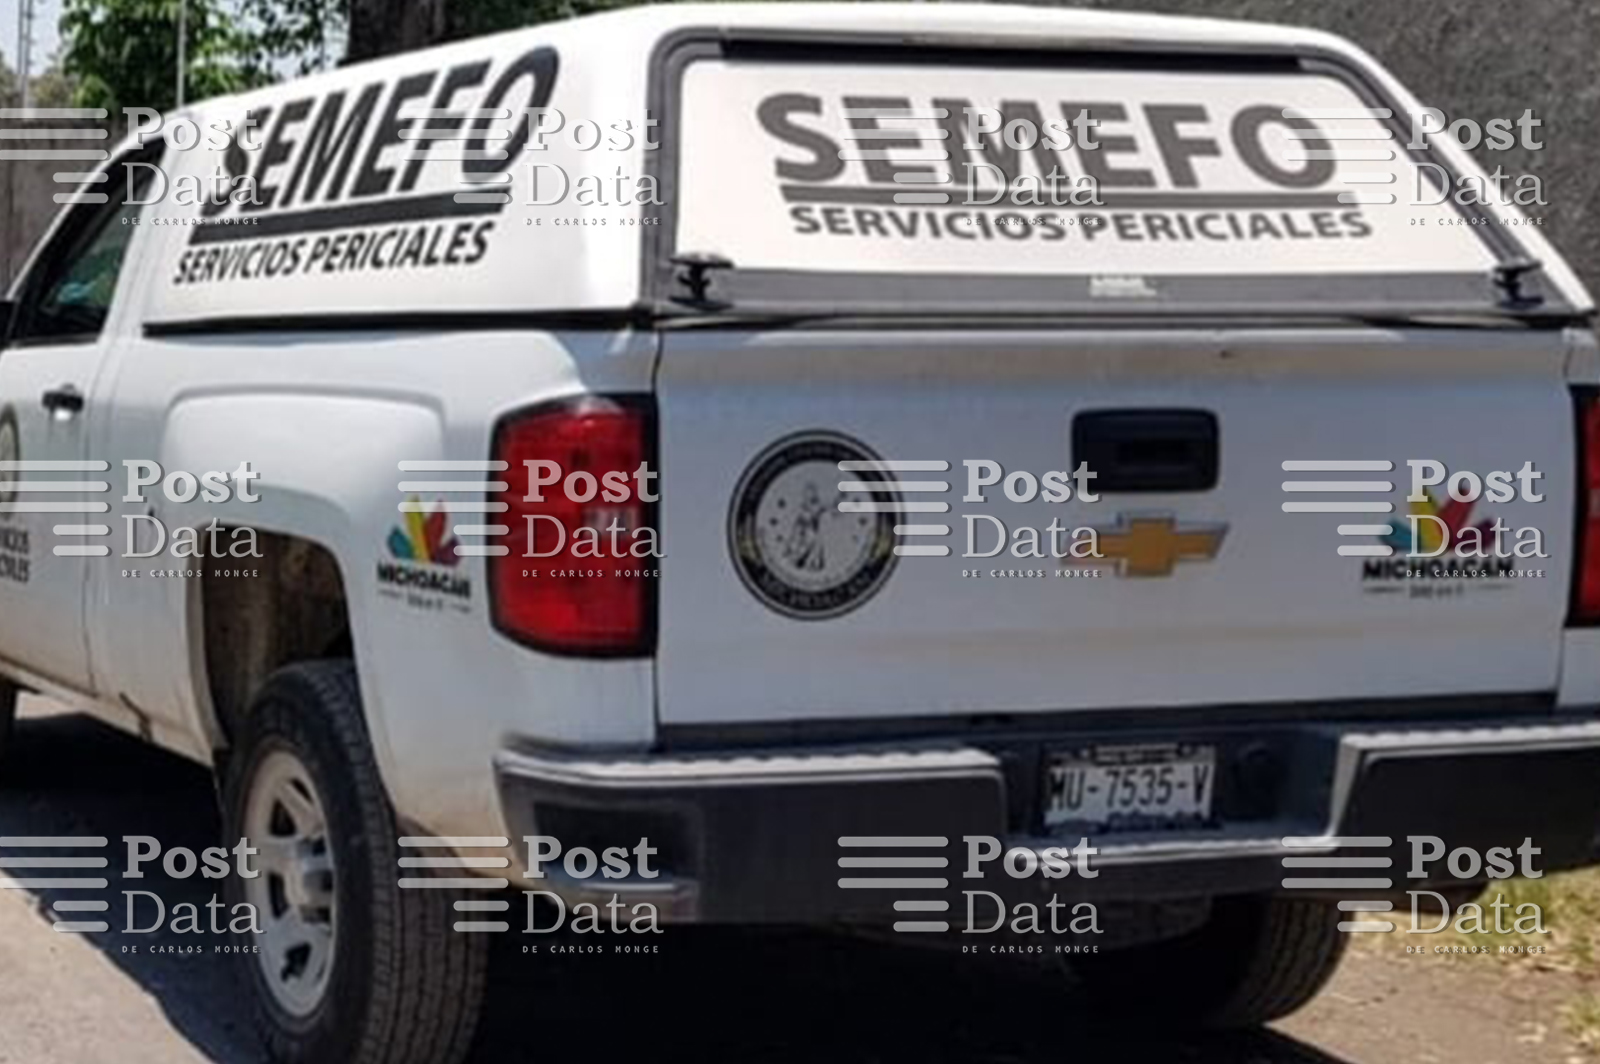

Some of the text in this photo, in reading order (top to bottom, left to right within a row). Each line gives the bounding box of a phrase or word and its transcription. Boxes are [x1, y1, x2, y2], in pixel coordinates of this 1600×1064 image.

[200, 46, 560, 216] SEMEFO
[755, 92, 1336, 190] SEMEFO
[173, 221, 495, 285] SERVICIOS PERICIALES
[789, 205, 1372, 240] SERVICIOS PERICIALES
